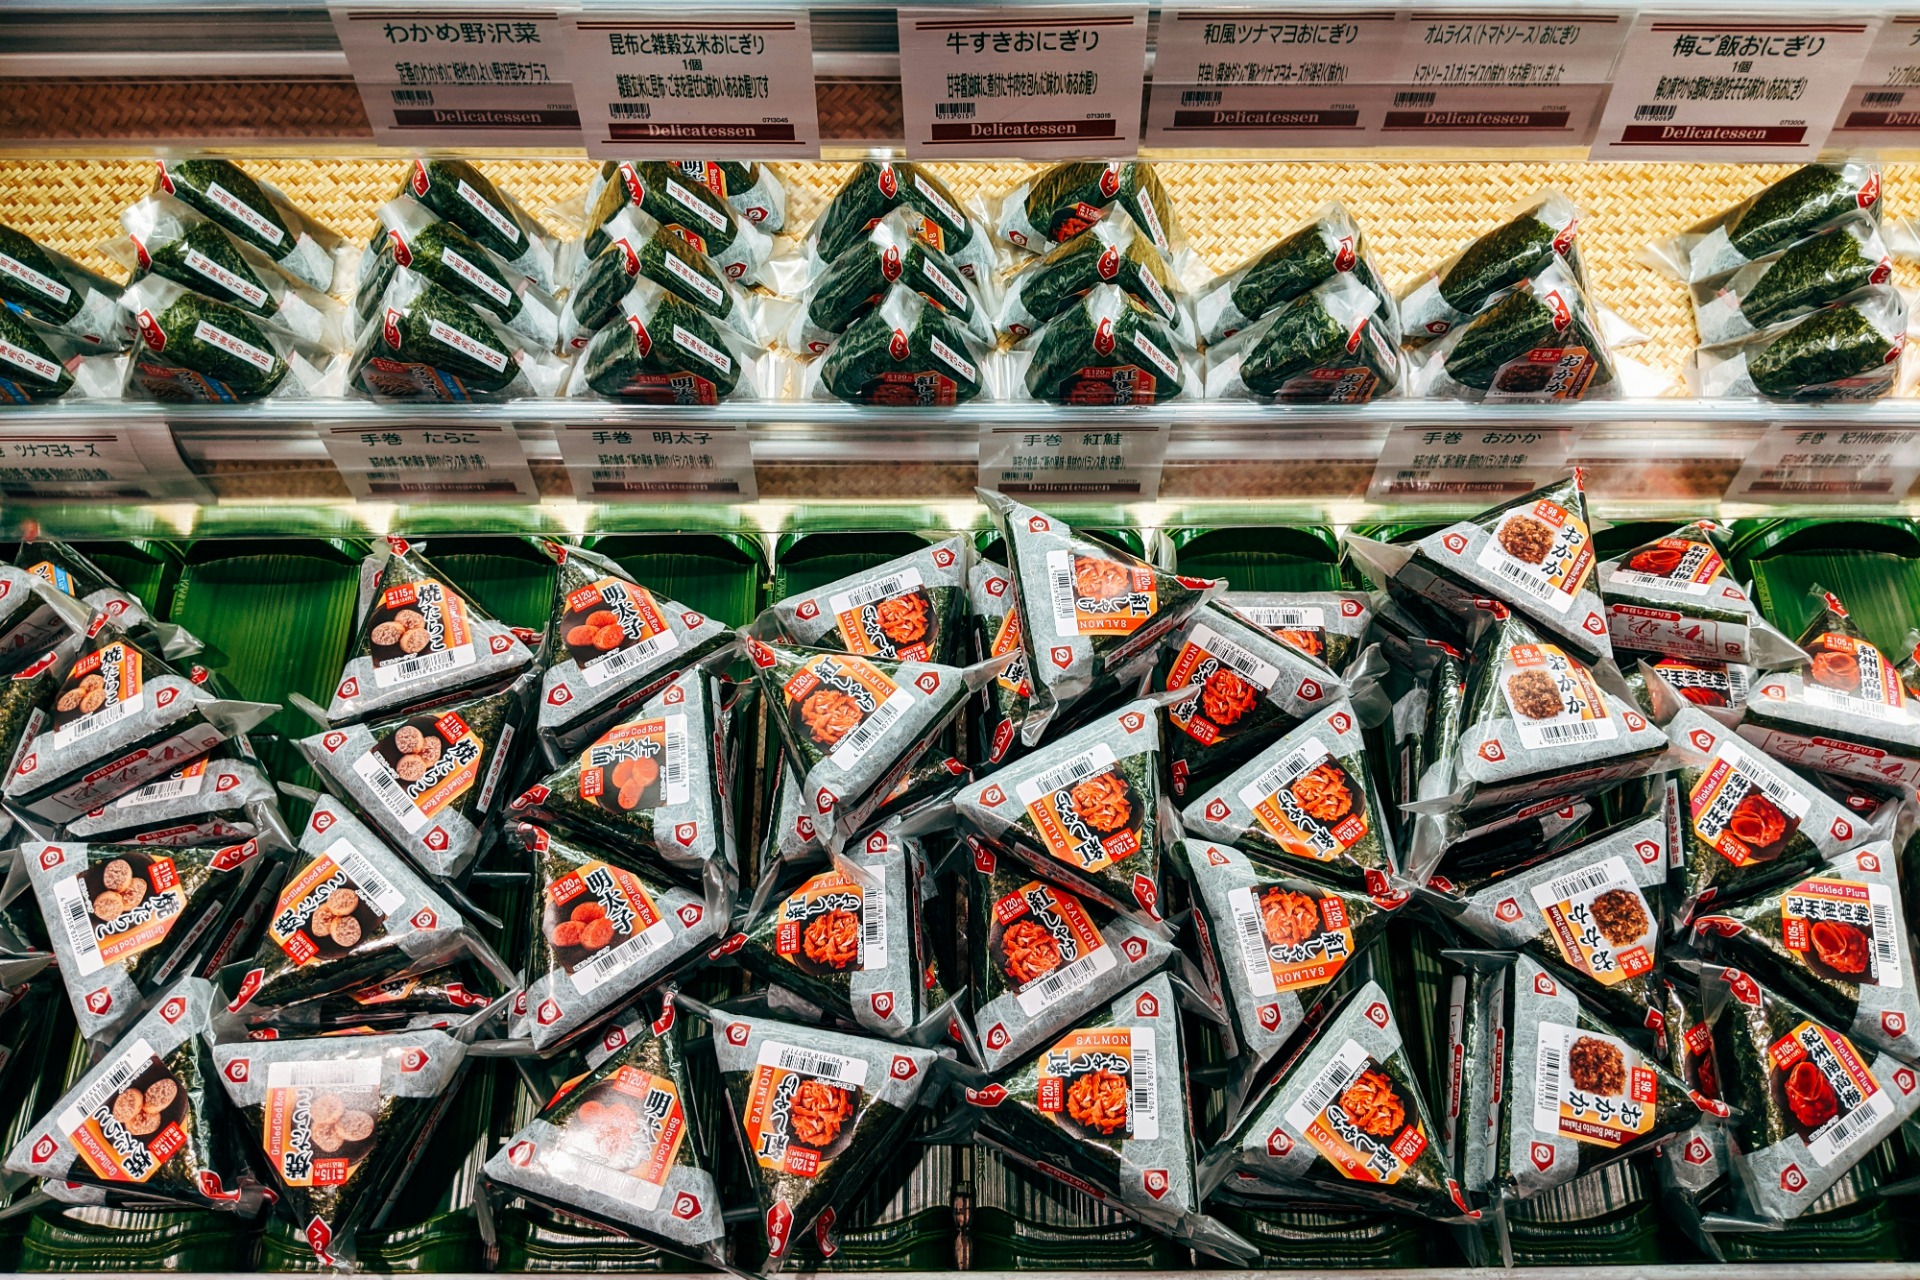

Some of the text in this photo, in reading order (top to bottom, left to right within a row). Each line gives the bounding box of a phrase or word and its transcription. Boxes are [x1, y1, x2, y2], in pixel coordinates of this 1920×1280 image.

[384, 22, 541, 43] わかめ野沢菜
[609, 33, 765, 55] 昆布と雑穀玄米おにぎり
[946, 29, 1099, 55] 牛すきおにぎり
[1204, 23, 1358, 44] 和風ツナマヨおにぎり
[1673, 34, 1825, 57] 梅ご飯おにぎり
[682, 59, 703, 71] 1個
[1732, 61, 1752, 72] 1個
[433, 110, 542, 123] Delicatessen
[648, 125, 756, 137] Delicatessen
[971, 123, 1077, 136] Delicatessen
[1213, 111, 1319, 123] Delicatessen
[1424, 113, 1530, 124] Delicatessen
[1662, 127, 1767, 139] Delicatessen
[1545, 354, 1583, 393] おかか
[14, 444, 101, 457] ツナマヨネーズ
[361, 432, 480, 447] 手巻 たらこ
[592, 431, 713, 445] 手巻 明太子
[1023, 433, 1123, 447] 手巻 紅鮭
[1422, 432, 1542, 445] 手巻 おかか
[1796, 432, 1827, 445] 手巻
[1540, 525, 1584, 578] おかか
[1672, 545, 1709, 581] 紀州南高梅
[418, 584, 447, 651] 焼たらこ
[602, 583, 644, 639] 明太子
[1077, 593, 1152, 616] 紅しゃけ
[1080, 619, 1127, 628] SALMON
[101, 644, 123, 708] 焼たらこ
[812, 656, 876, 712] 紅しゃけ
[852, 661, 892, 697] SALMON
[1171, 646, 1199, 687] SALMON
[1858, 645, 1883, 703] 紀州南高梅
[1547, 654, 1587, 716] おかか
[632, 727, 647, 737] Cod
[407, 738, 479, 799] 焼たらこ
[591, 737, 661, 767] 明太子
[1257, 802, 1296, 845] SALMON
[1276, 788, 1337, 859] 紅しゃけ
[1698, 772, 1752, 840] 紀州南高梅
[1033, 800, 1067, 849] SALMON
[1055, 790, 1105, 869] 紅しゃけ
[273, 871, 348, 937] 焼たらこ
[584, 867, 636, 935] 明太子
[619, 874, 653, 925] Spicy Cod Roe
[786, 893, 862, 921] 紅しゃけ
[1786, 896, 1872, 925] 紀州南高梅
[1845, 887, 1868, 898] Plum
[96, 892, 181, 940] 焼たらこ
[1026, 885, 1079, 962] 紅しゃけ
[1064, 902, 1098, 950] SALMON
[1268, 932, 1349, 964] 紅しゃけ
[1567, 903, 1616, 973] おかか
[1275, 966, 1325, 985] SALMON
[1076, 1036, 1129, 1045] SALMON
[1046, 1050, 1129, 1077] 紅しゃけ
[1800, 1026, 1862, 1109] 紀州南高梅
[752, 1067, 772, 1123] SALMON
[1855, 1070, 1873, 1094] Plum
[759, 1074, 799, 1161] 紅しゃけ
[1569, 1091, 1645, 1130] おかか
[93, 1106, 154, 1179] 焼たらこ
[284, 1088, 313, 1179] 焼たらこ
[1310, 1124, 1356, 1170] SALMON
[1327, 1105, 1399, 1182] 紅しゃけ
